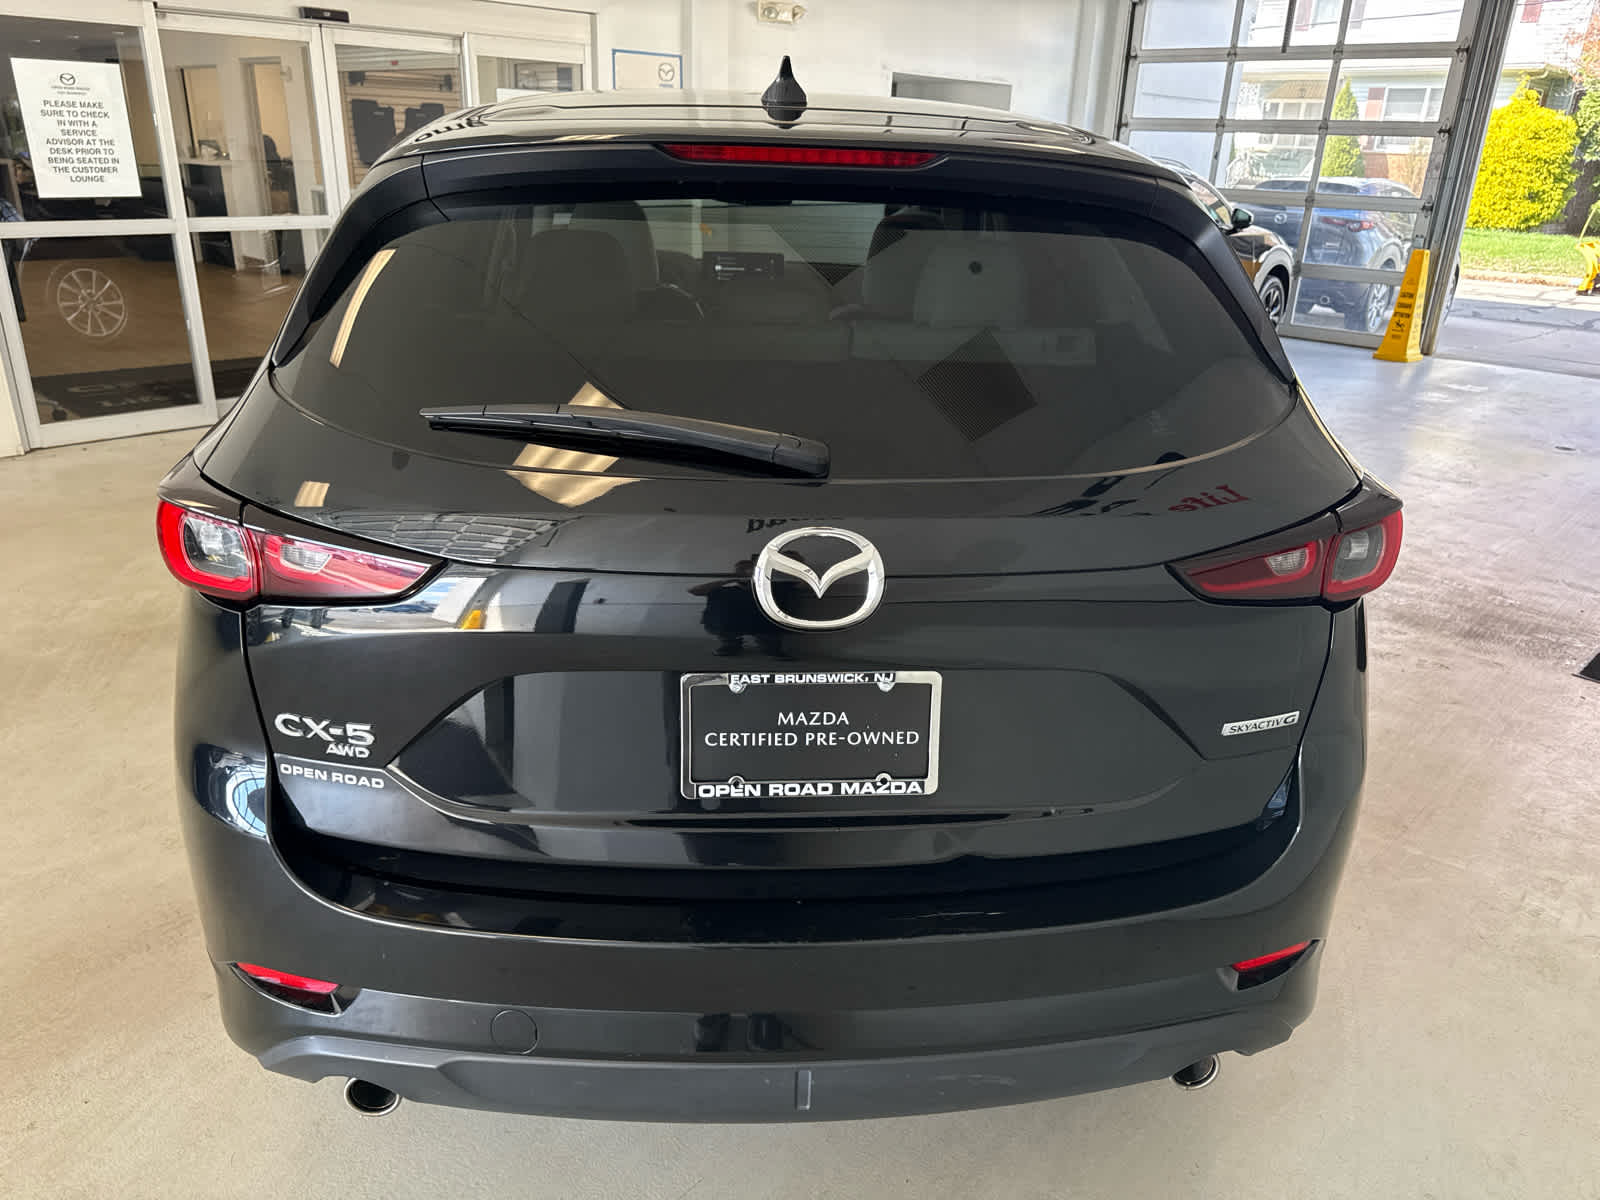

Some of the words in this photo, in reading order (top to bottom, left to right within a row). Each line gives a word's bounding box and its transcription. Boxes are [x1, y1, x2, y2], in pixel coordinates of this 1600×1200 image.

[43, 100, 78, 108] PLEASE
[80, 101, 104, 109] MAKE
[40, 109, 64, 117] SURE
[66, 110, 78, 118] TO
[80, 111, 109, 119] CHECK
[91, 120, 98, 128] A
[50, 147, 73, 155] DESK
[48, 156, 74, 164] BEING
[730, 673, 770, 684] EAST
[774, 672, 869, 684] BRUNSWICK,
[873, 672, 894, 683] NJ
[777, 711, 850, 726] MAZDA
[274, 712, 375, 746] CX-5
[704, 731, 798, 747] CERTIFIED
[805, 730, 920, 746] PRE-OWNED
[325, 743, 371, 759] AWD
[279, 763, 328, 781] OPEN
[331, 772, 385, 789] ROAD
[698, 782, 761, 798] OPEN
[768, 783, 833, 797] ROAD
[840, 780, 924, 796] MAZDA
